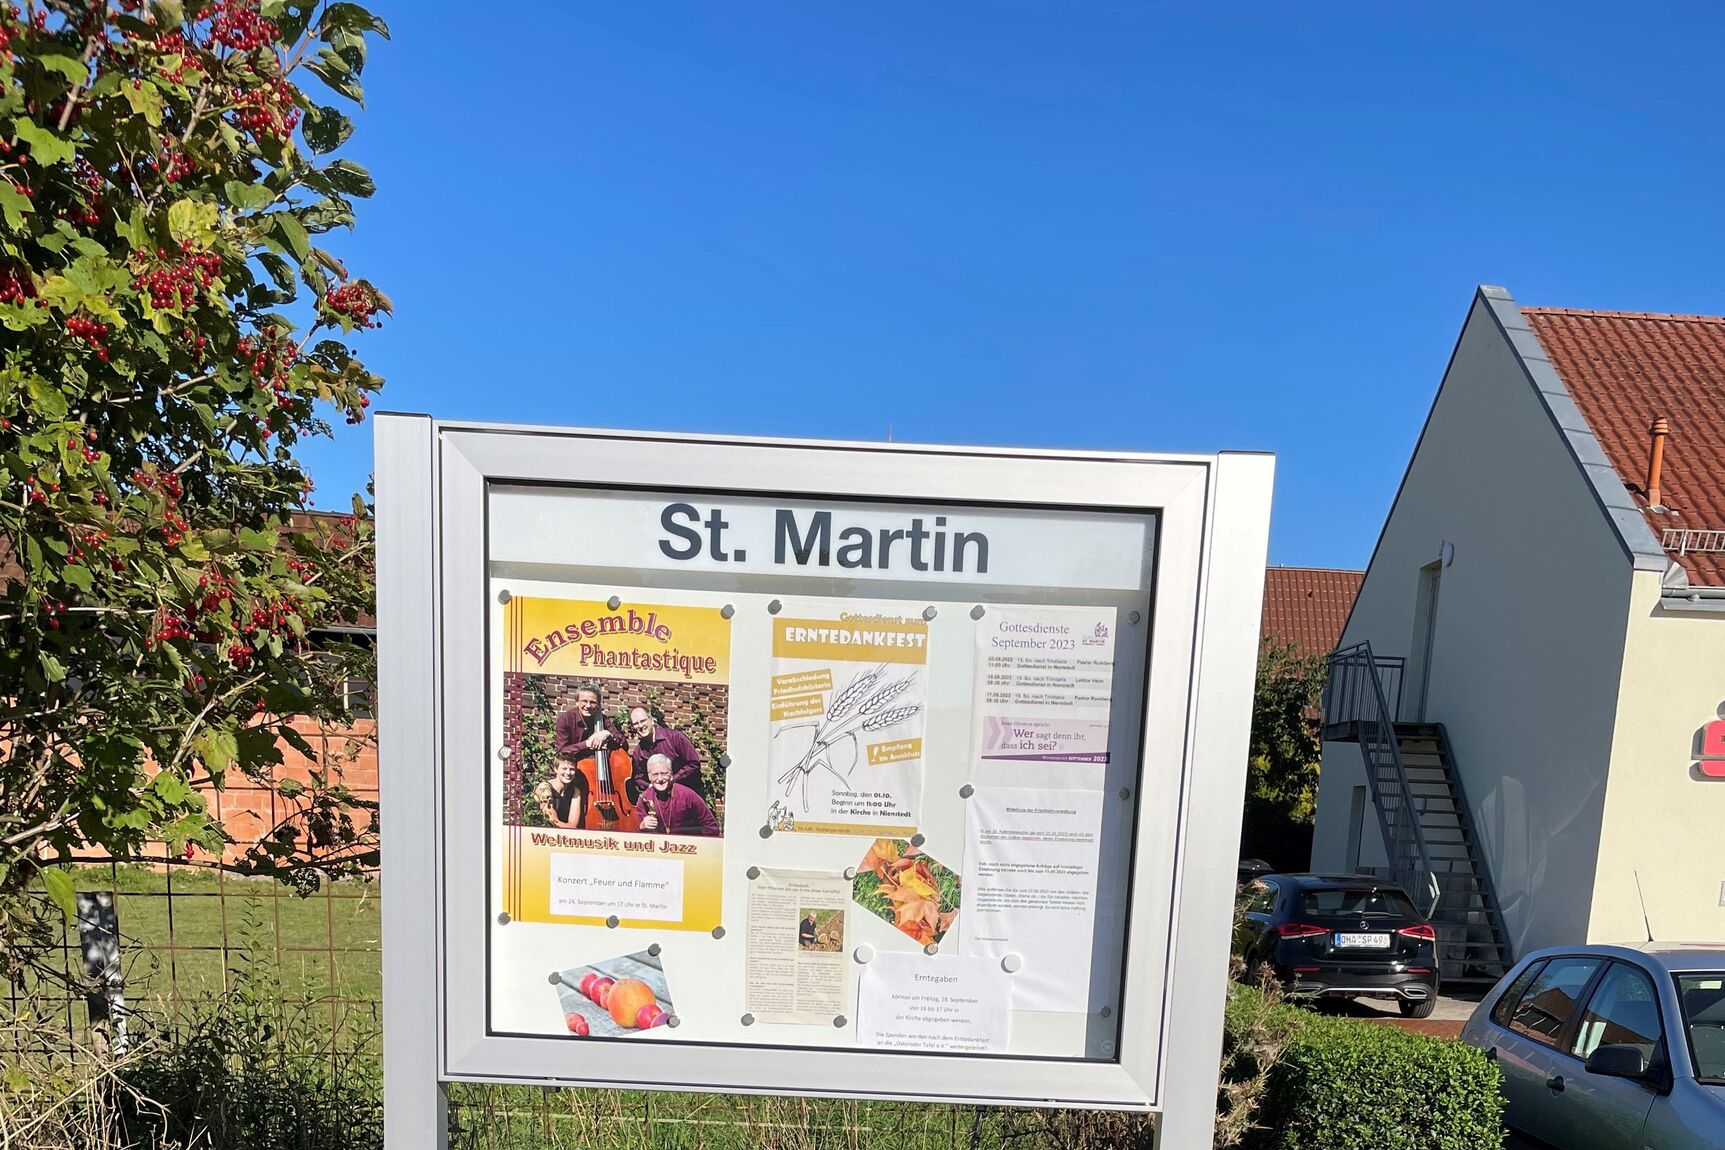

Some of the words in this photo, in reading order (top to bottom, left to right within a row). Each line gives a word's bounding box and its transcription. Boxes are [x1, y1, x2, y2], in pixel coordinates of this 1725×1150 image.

[659, 503, 746, 562] St.
[774, 509, 990, 573] Martin
[1000, 621, 1070, 634] Gottesdienste
[524, 609, 672, 666] Ensemble
[785, 627, 926, 648] ERNTEDANKFEST
[992, 637, 1047, 650] September
[1050, 640, 1075, 650] 2023
[579, 644, 716, 678] Phantastique
[776, 673, 829, 685] Verabschiedung
[1014, 729, 1034, 738] Wer
[1036, 732, 1051, 740] sagt
[1053, 732, 1071, 740] denn
[1074, 733, 1086, 741] ihr,
[1020, 740, 1034, 750] ich
[1038, 741, 1057, 751] sei?
[832, 790, 857, 798] Sonntag,
[832, 799, 853, 807] Beginn
[530, 832, 620, 851] Weltmusik
[623, 840, 655, 853] und
[658, 840, 698, 855] Jazz
[558, 876, 587, 885] Konzert
[618, 880, 632, 888] und
[915, 974, 958, 983] Erntegaben
